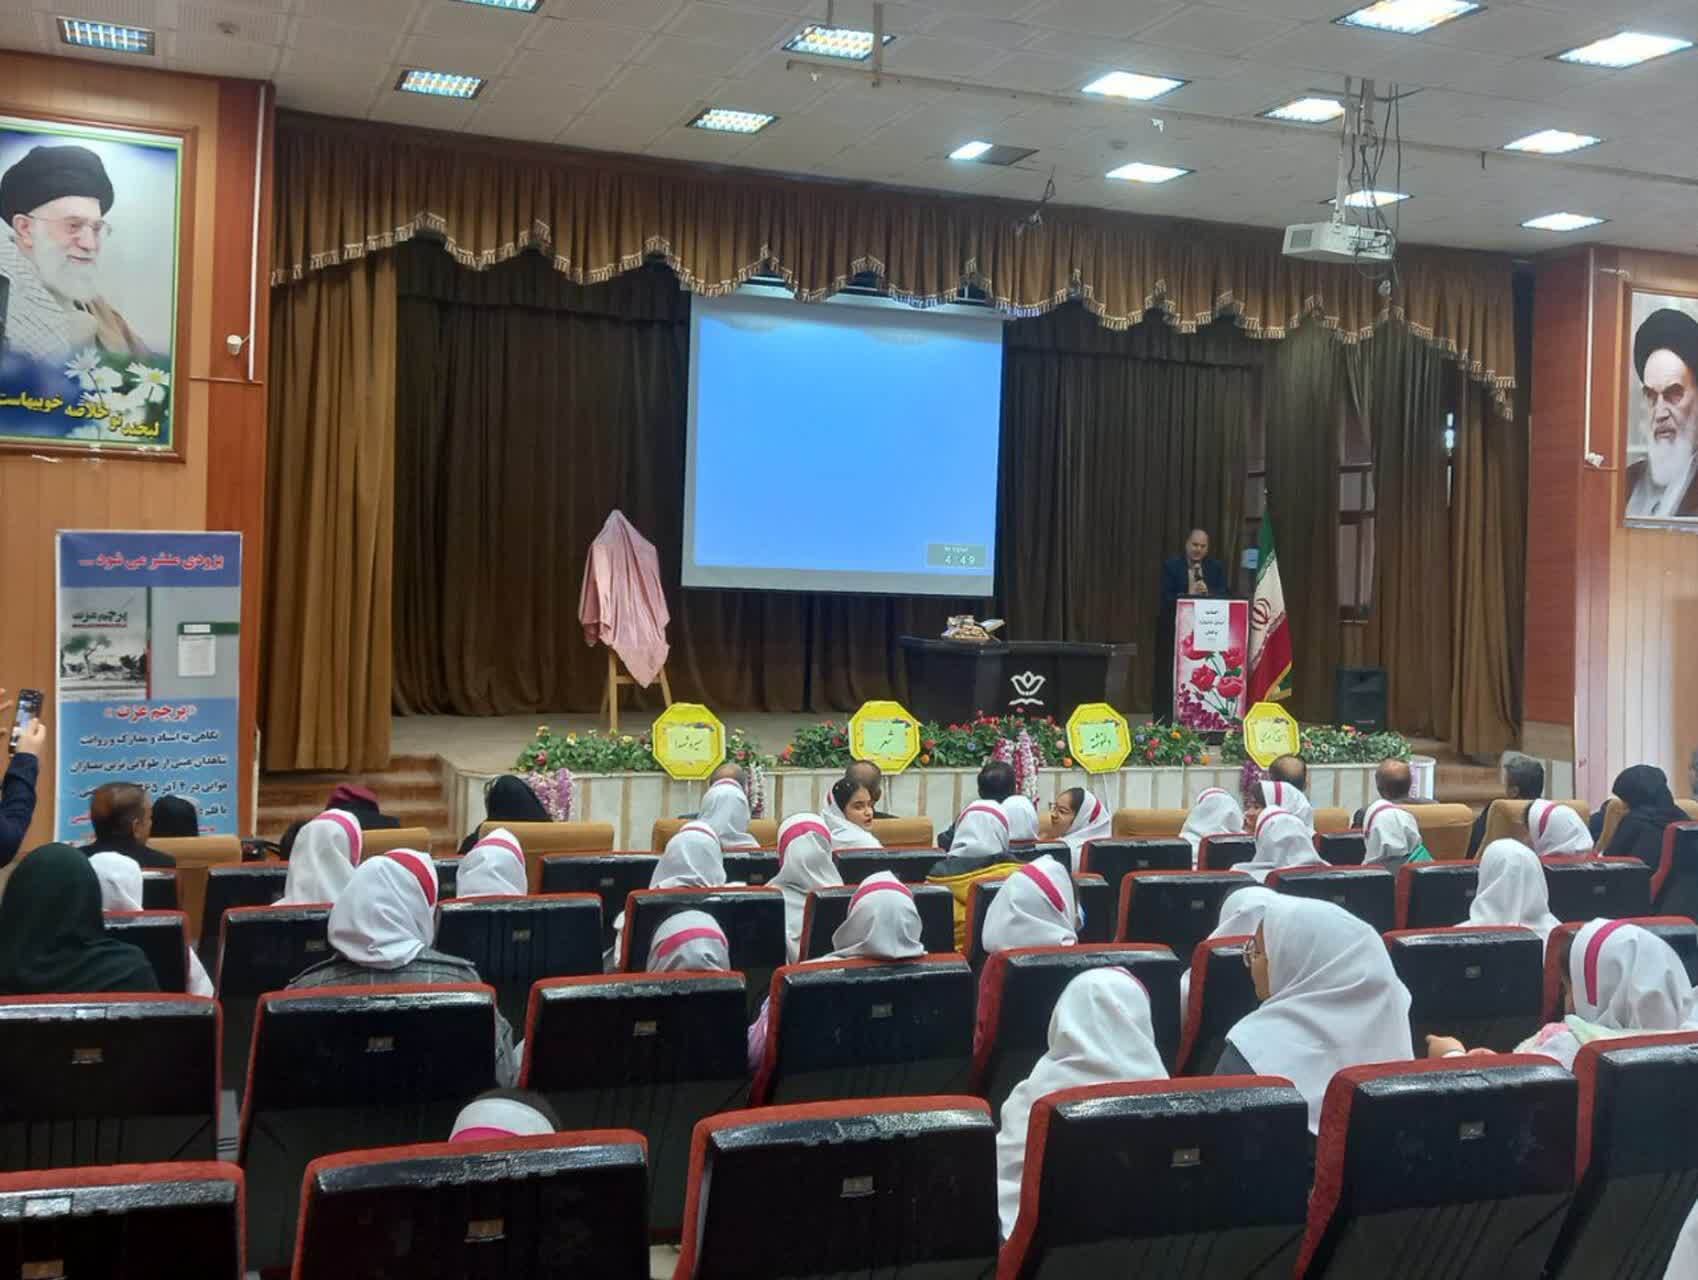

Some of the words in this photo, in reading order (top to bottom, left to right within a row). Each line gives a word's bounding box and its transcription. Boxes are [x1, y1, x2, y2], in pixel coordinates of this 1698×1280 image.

[64, 401, 110, 419] خلاصه
[108, 412, 124, 432] تو
[121, 419, 161, 438] لبخند
